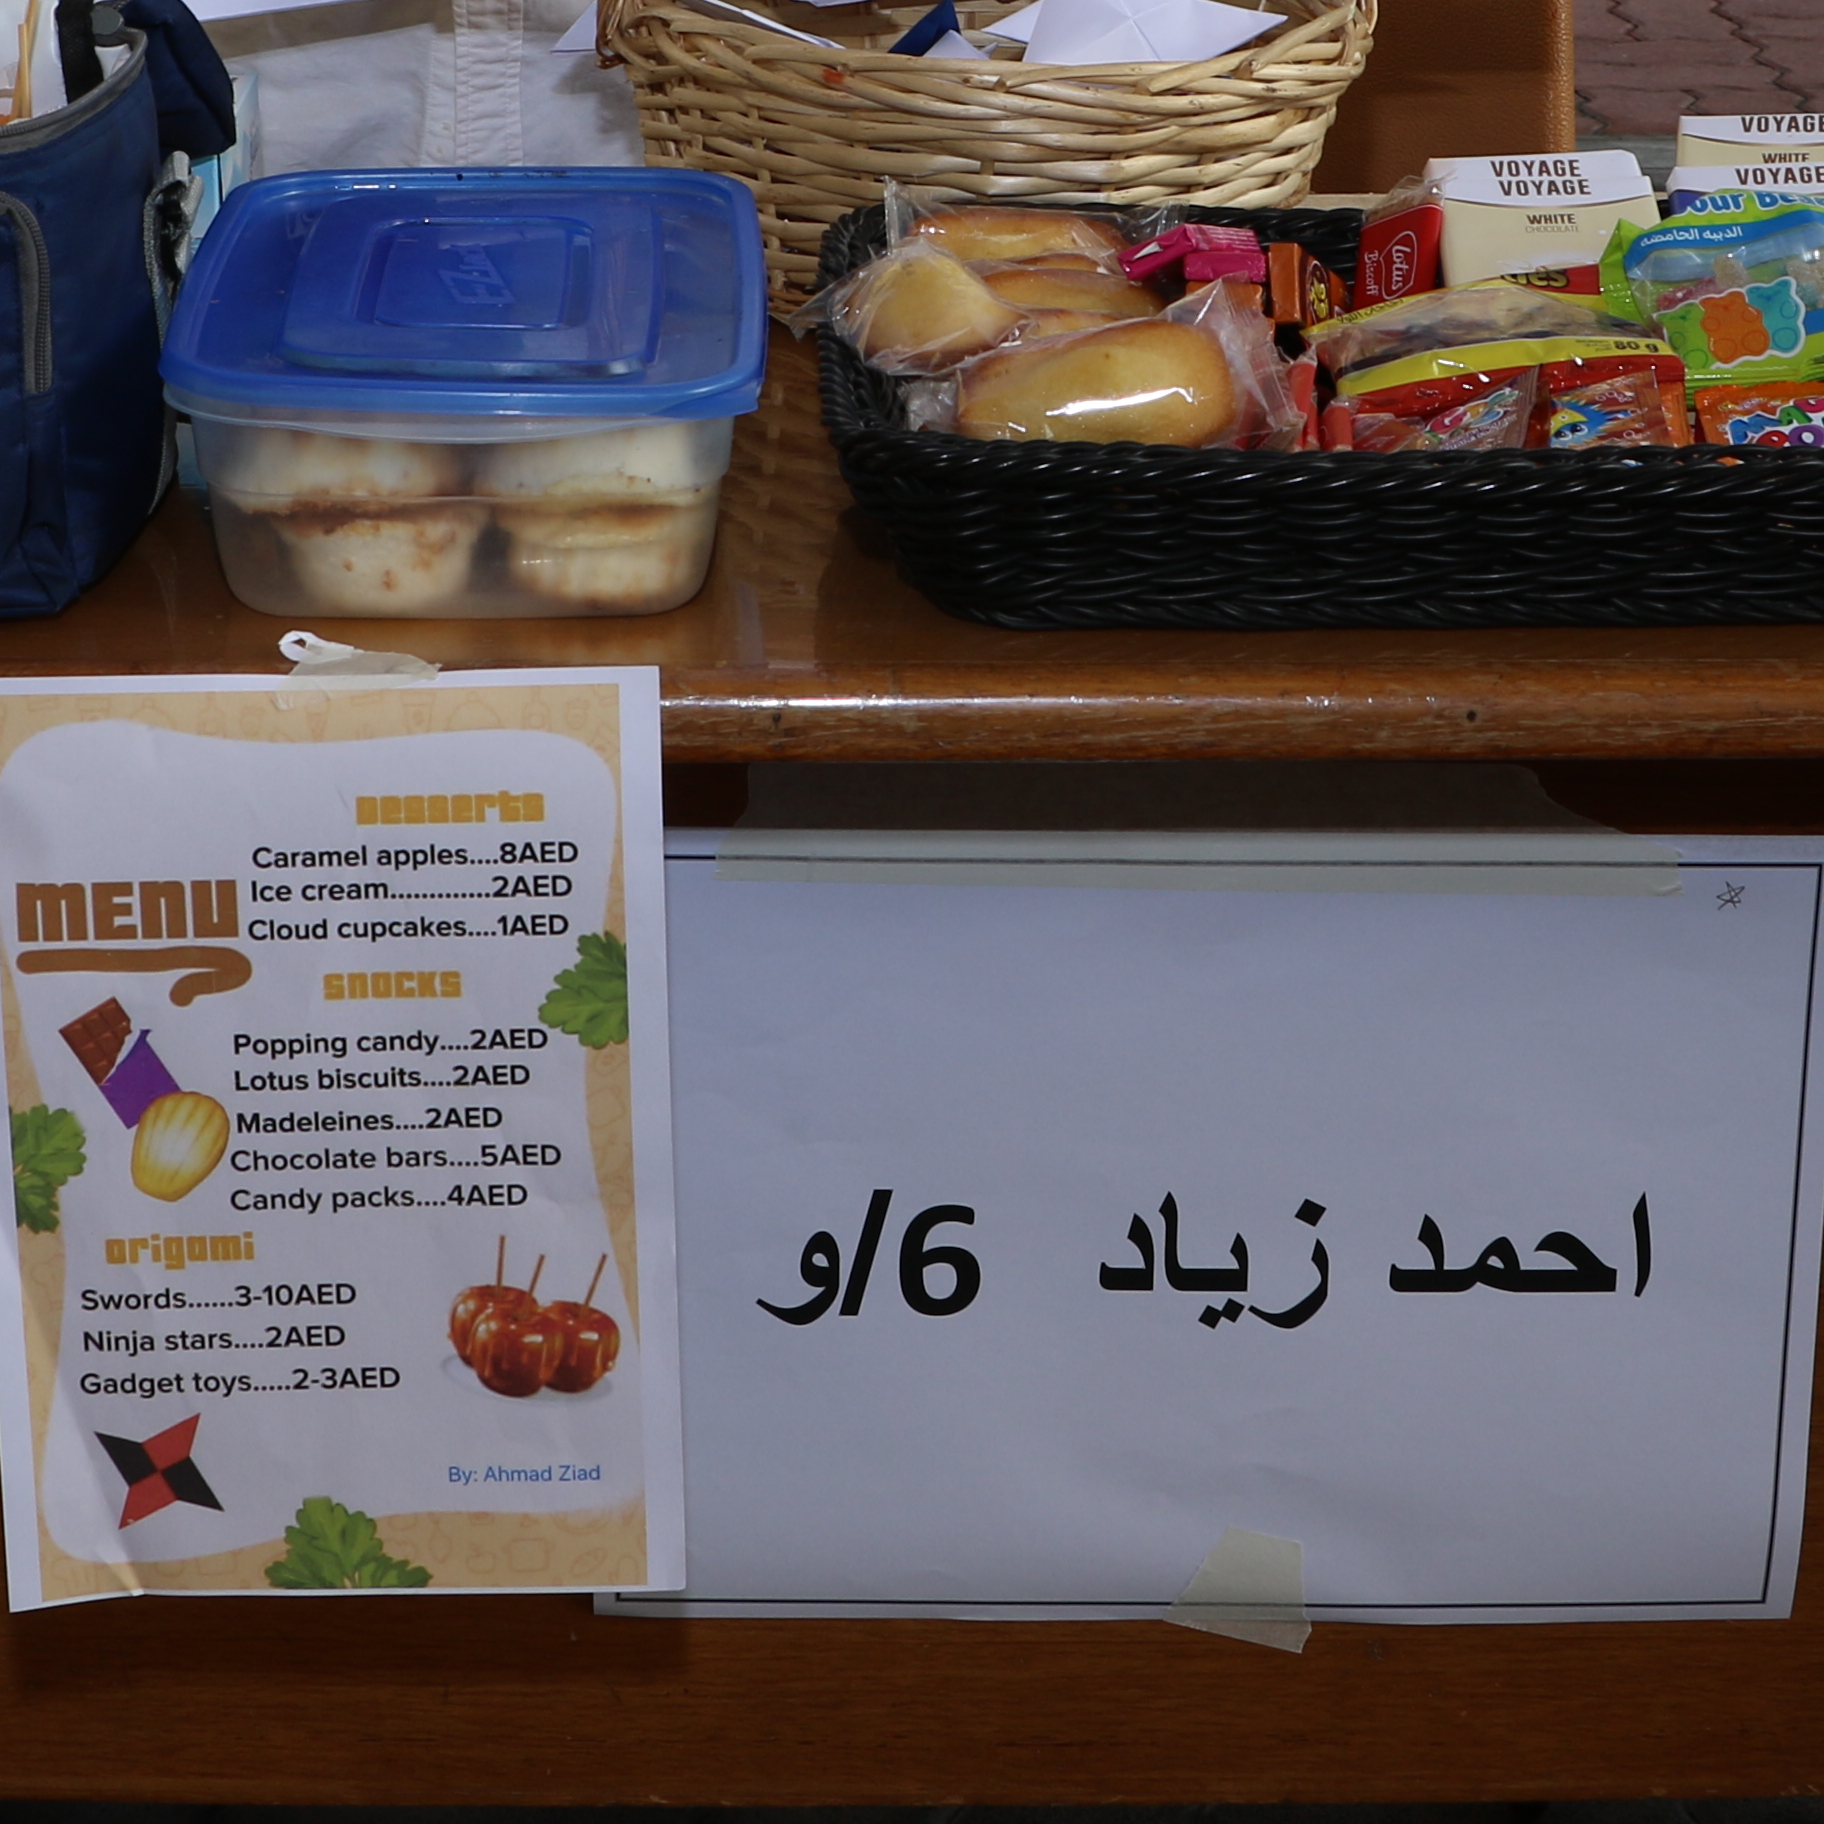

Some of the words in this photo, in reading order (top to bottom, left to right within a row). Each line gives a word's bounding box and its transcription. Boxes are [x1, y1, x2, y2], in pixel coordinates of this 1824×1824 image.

[1490, 159, 1581, 178] VOYAGE
[1762, 152, 1810, 164] WHITE
[1498, 178, 1591, 197] VOYAGE
[1524, 225, 1579, 234] CHOCOLATE
[1526, 213, 1576, 225] WHITE
[1364, 250, 1379, 297] Biscoff
[1391, 244, 1412, 291] Lotus
[1613, 339, 1640, 351] 80
[252, 844, 368, 869] Caramel
[251, 880, 292, 903] Ice
[17, 880, 240, 943] MENU
[248, 918, 328, 941] Cloud
[233, 1033, 347, 1060] Popping
[234, 1070, 309, 1092] Lotus
[230, 1148, 377, 1172] Chocolate
[230, 1187, 323, 1215] Candy
[1389, 1191, 1652, 1298] احمد
[1099, 1191, 1329, 1330] زياد
[83, 1330, 155, 1357] Ninja
[80, 1372, 185, 1399] Gadget
[448, 1465, 478, 1483] By:
[485, 1466, 553, 1482] Ahmad
[560, 1463, 601, 1481] Ziad
